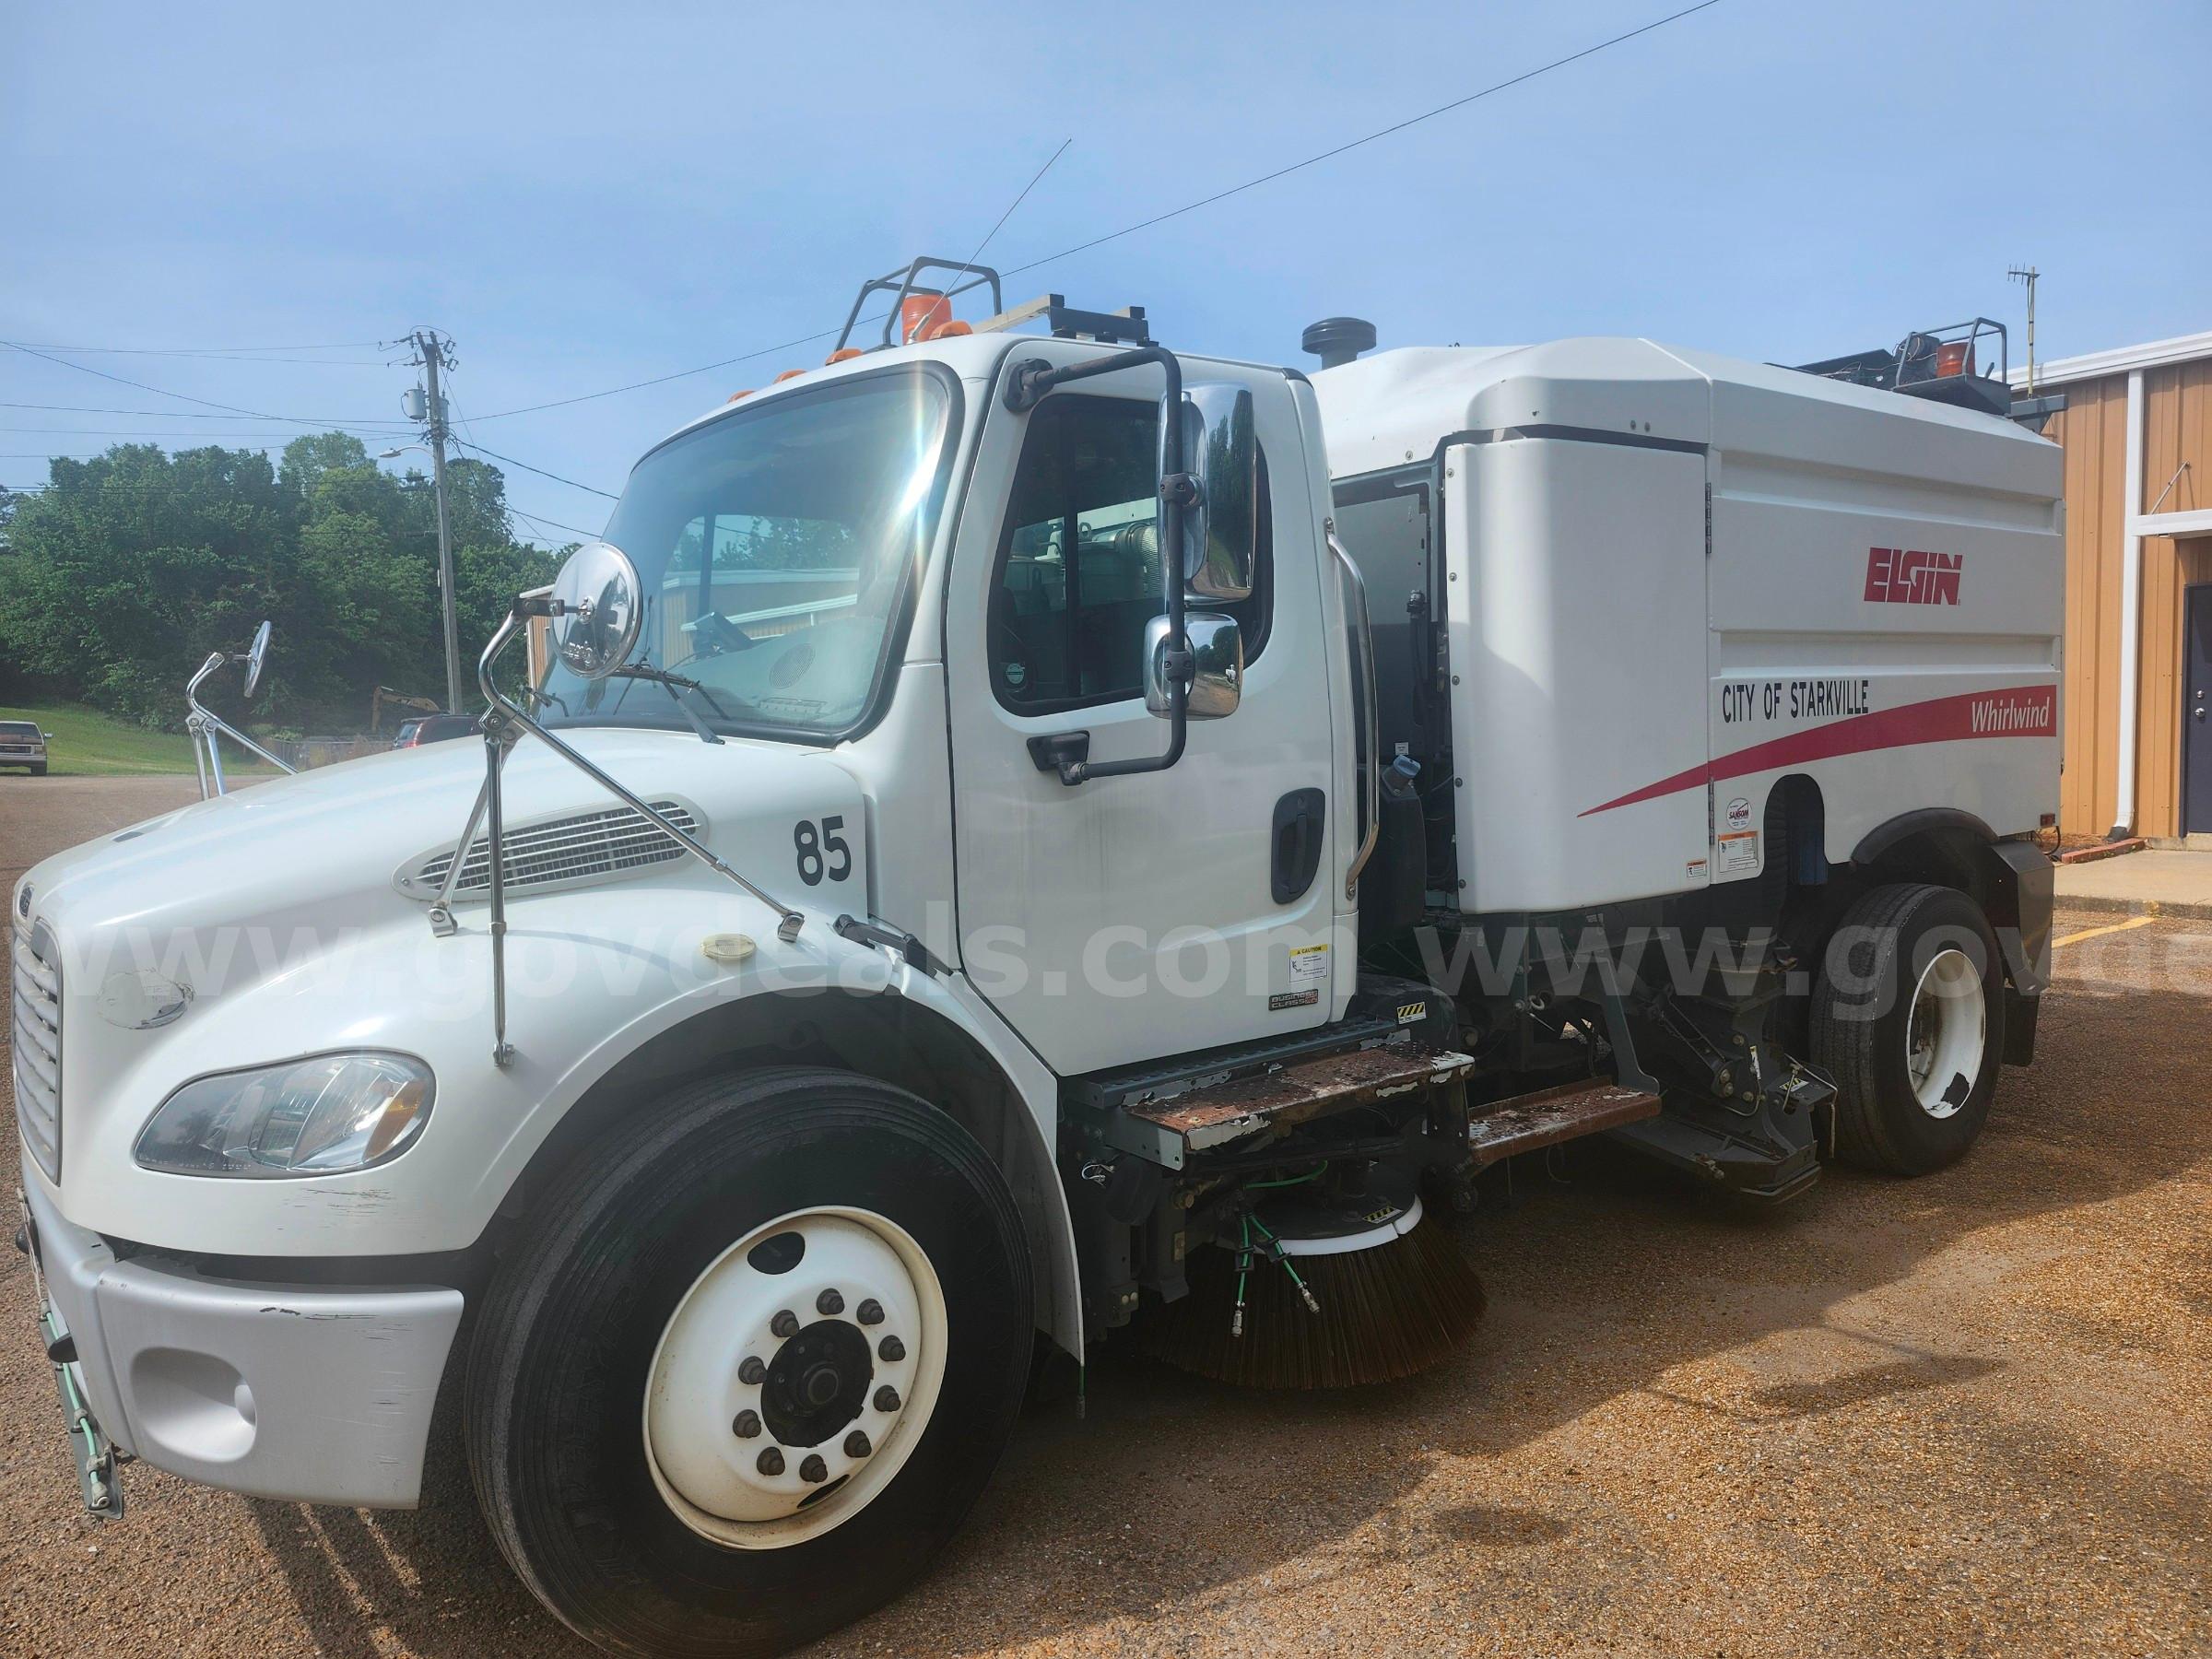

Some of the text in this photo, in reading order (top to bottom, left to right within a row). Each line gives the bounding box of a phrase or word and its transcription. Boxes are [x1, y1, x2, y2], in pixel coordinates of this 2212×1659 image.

[1864, 547, 1963, 606] ELGIN
[1722, 679, 1869, 724] CITY OF STARKVILLE
[1971, 697, 2050, 733] Whirlwind
[794, 815, 852, 887] 85
[1301, 946, 1322, 954] CAUTION
